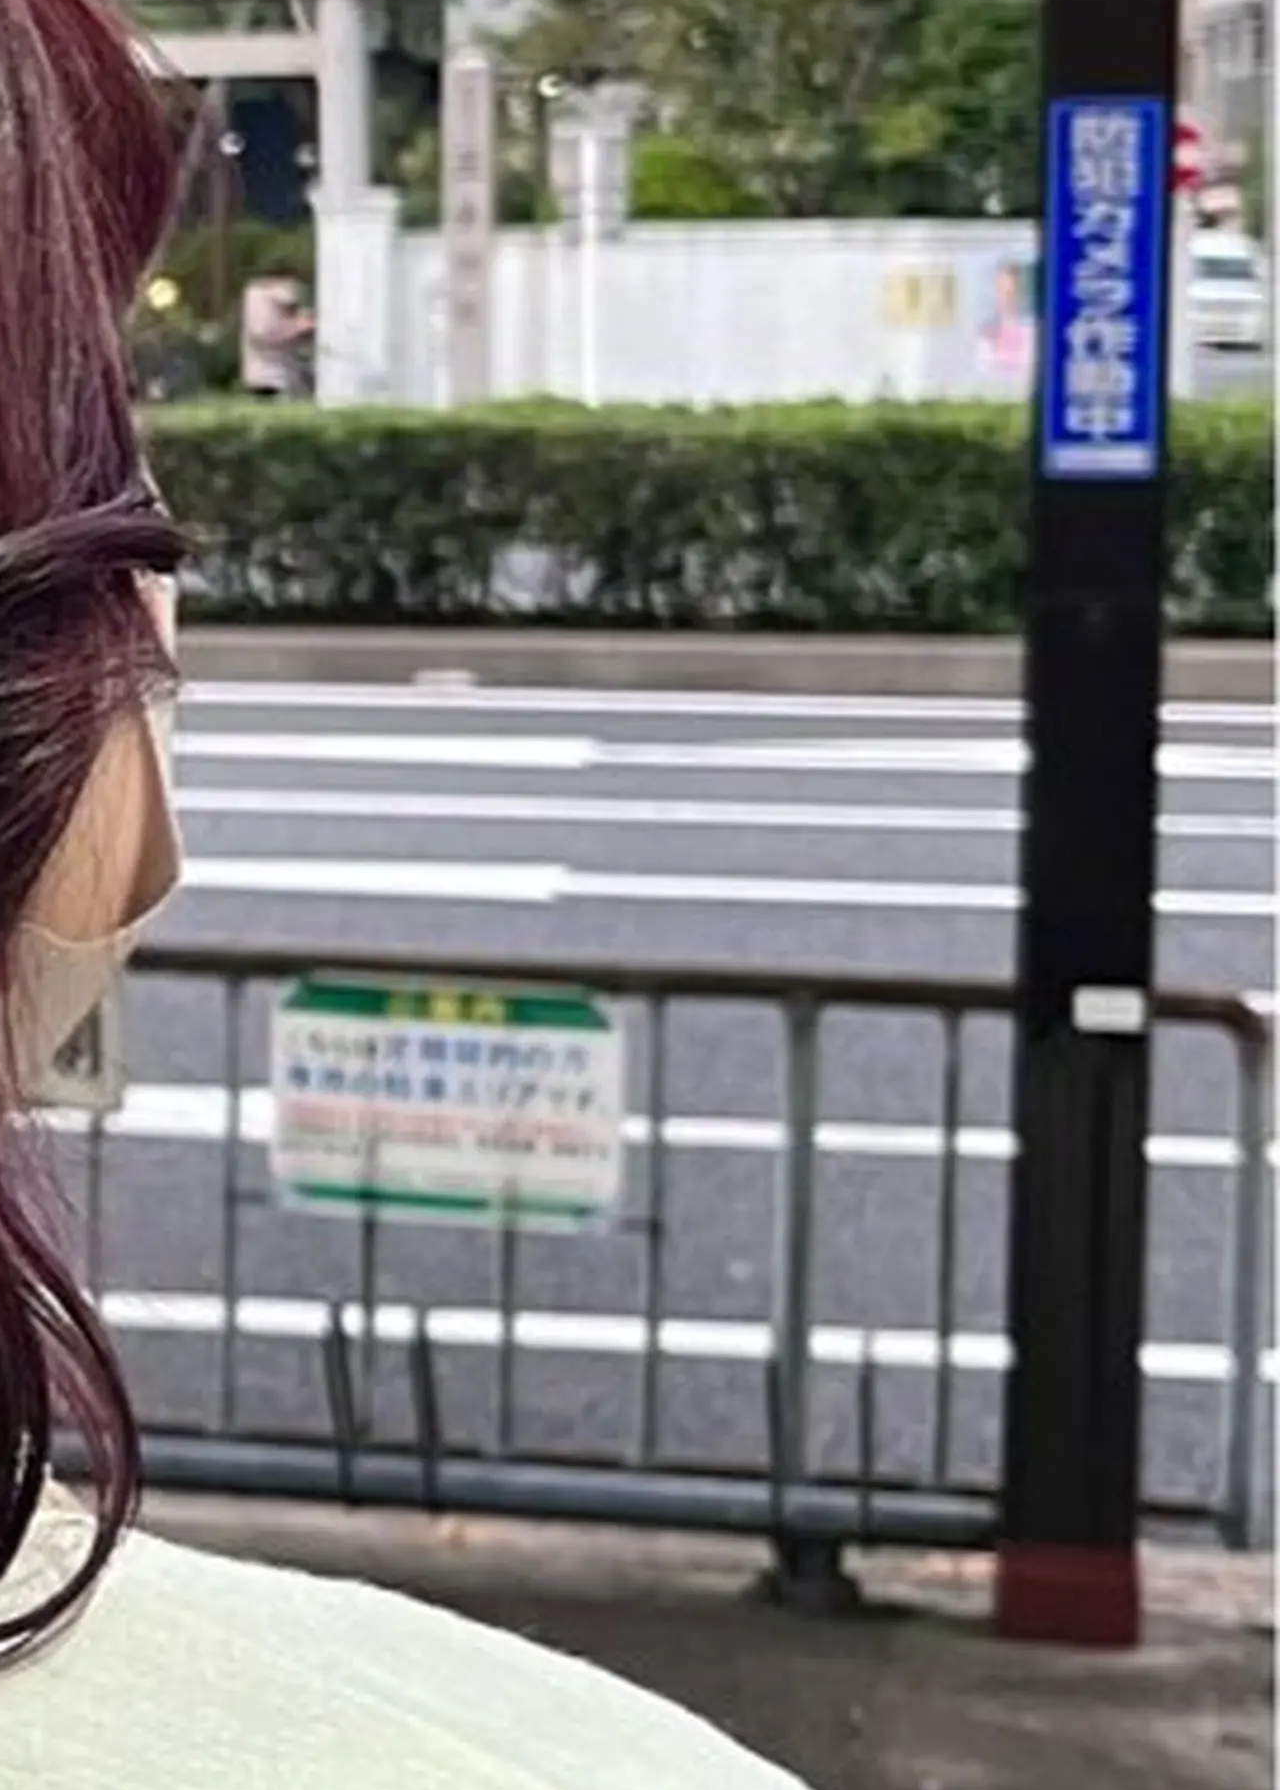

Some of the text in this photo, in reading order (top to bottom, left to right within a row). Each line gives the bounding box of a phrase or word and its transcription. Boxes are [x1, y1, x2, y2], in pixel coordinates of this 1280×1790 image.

[1064, 107, 1141, 442] 防犯カメラ作動中
